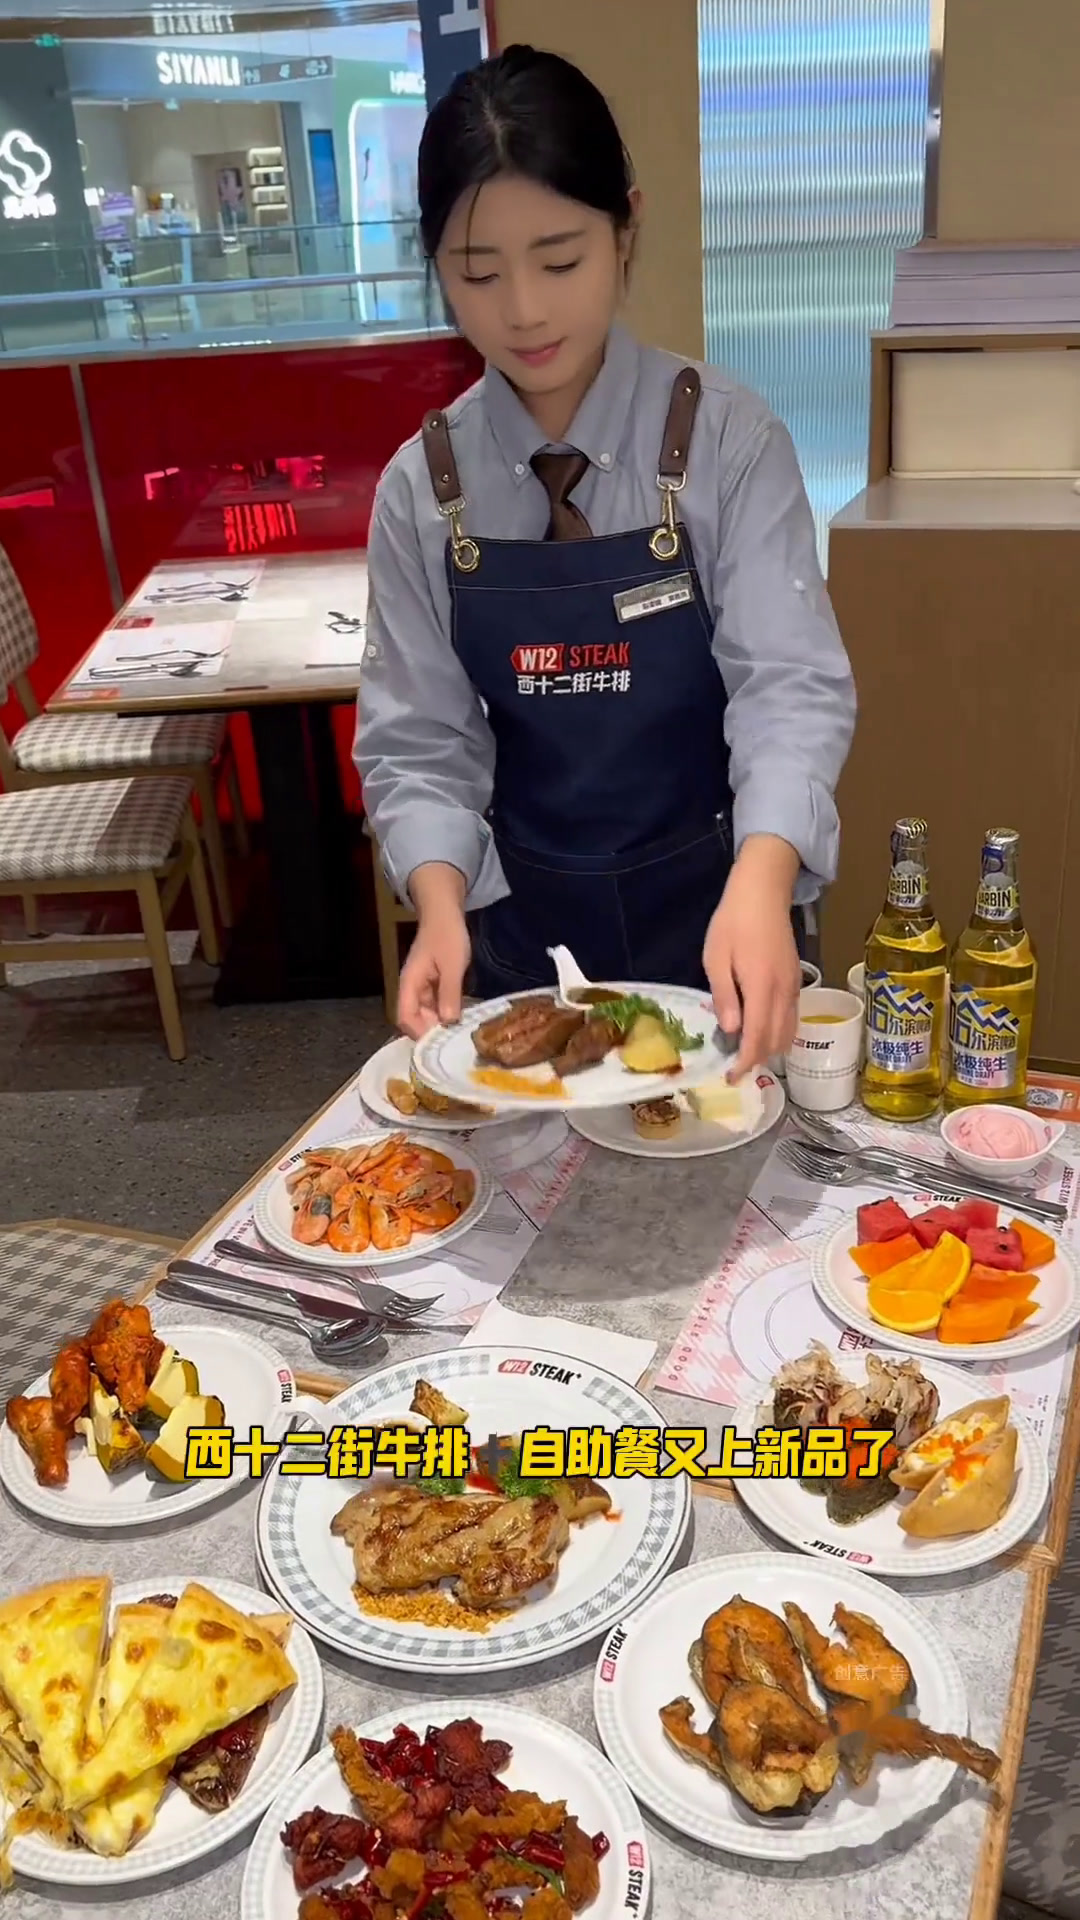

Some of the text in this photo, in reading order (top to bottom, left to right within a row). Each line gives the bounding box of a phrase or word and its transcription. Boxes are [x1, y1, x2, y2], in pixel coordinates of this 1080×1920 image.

[156, 51, 240, 87] SIYANLI
[519, 641, 630, 672] W12 STEAK
[517, 669, 631, 695] 西十二街牛排
[805, 1040, 830, 1050] STEAK
[933, 1194, 961, 1202] STEAK
[501, 1360, 575, 1385] W12 STEAK
[809, 1540, 847, 1558] STEAK
[605, 1627, 628, 1660] STEAK
[624, 1869, 644, 1911] STEAK
